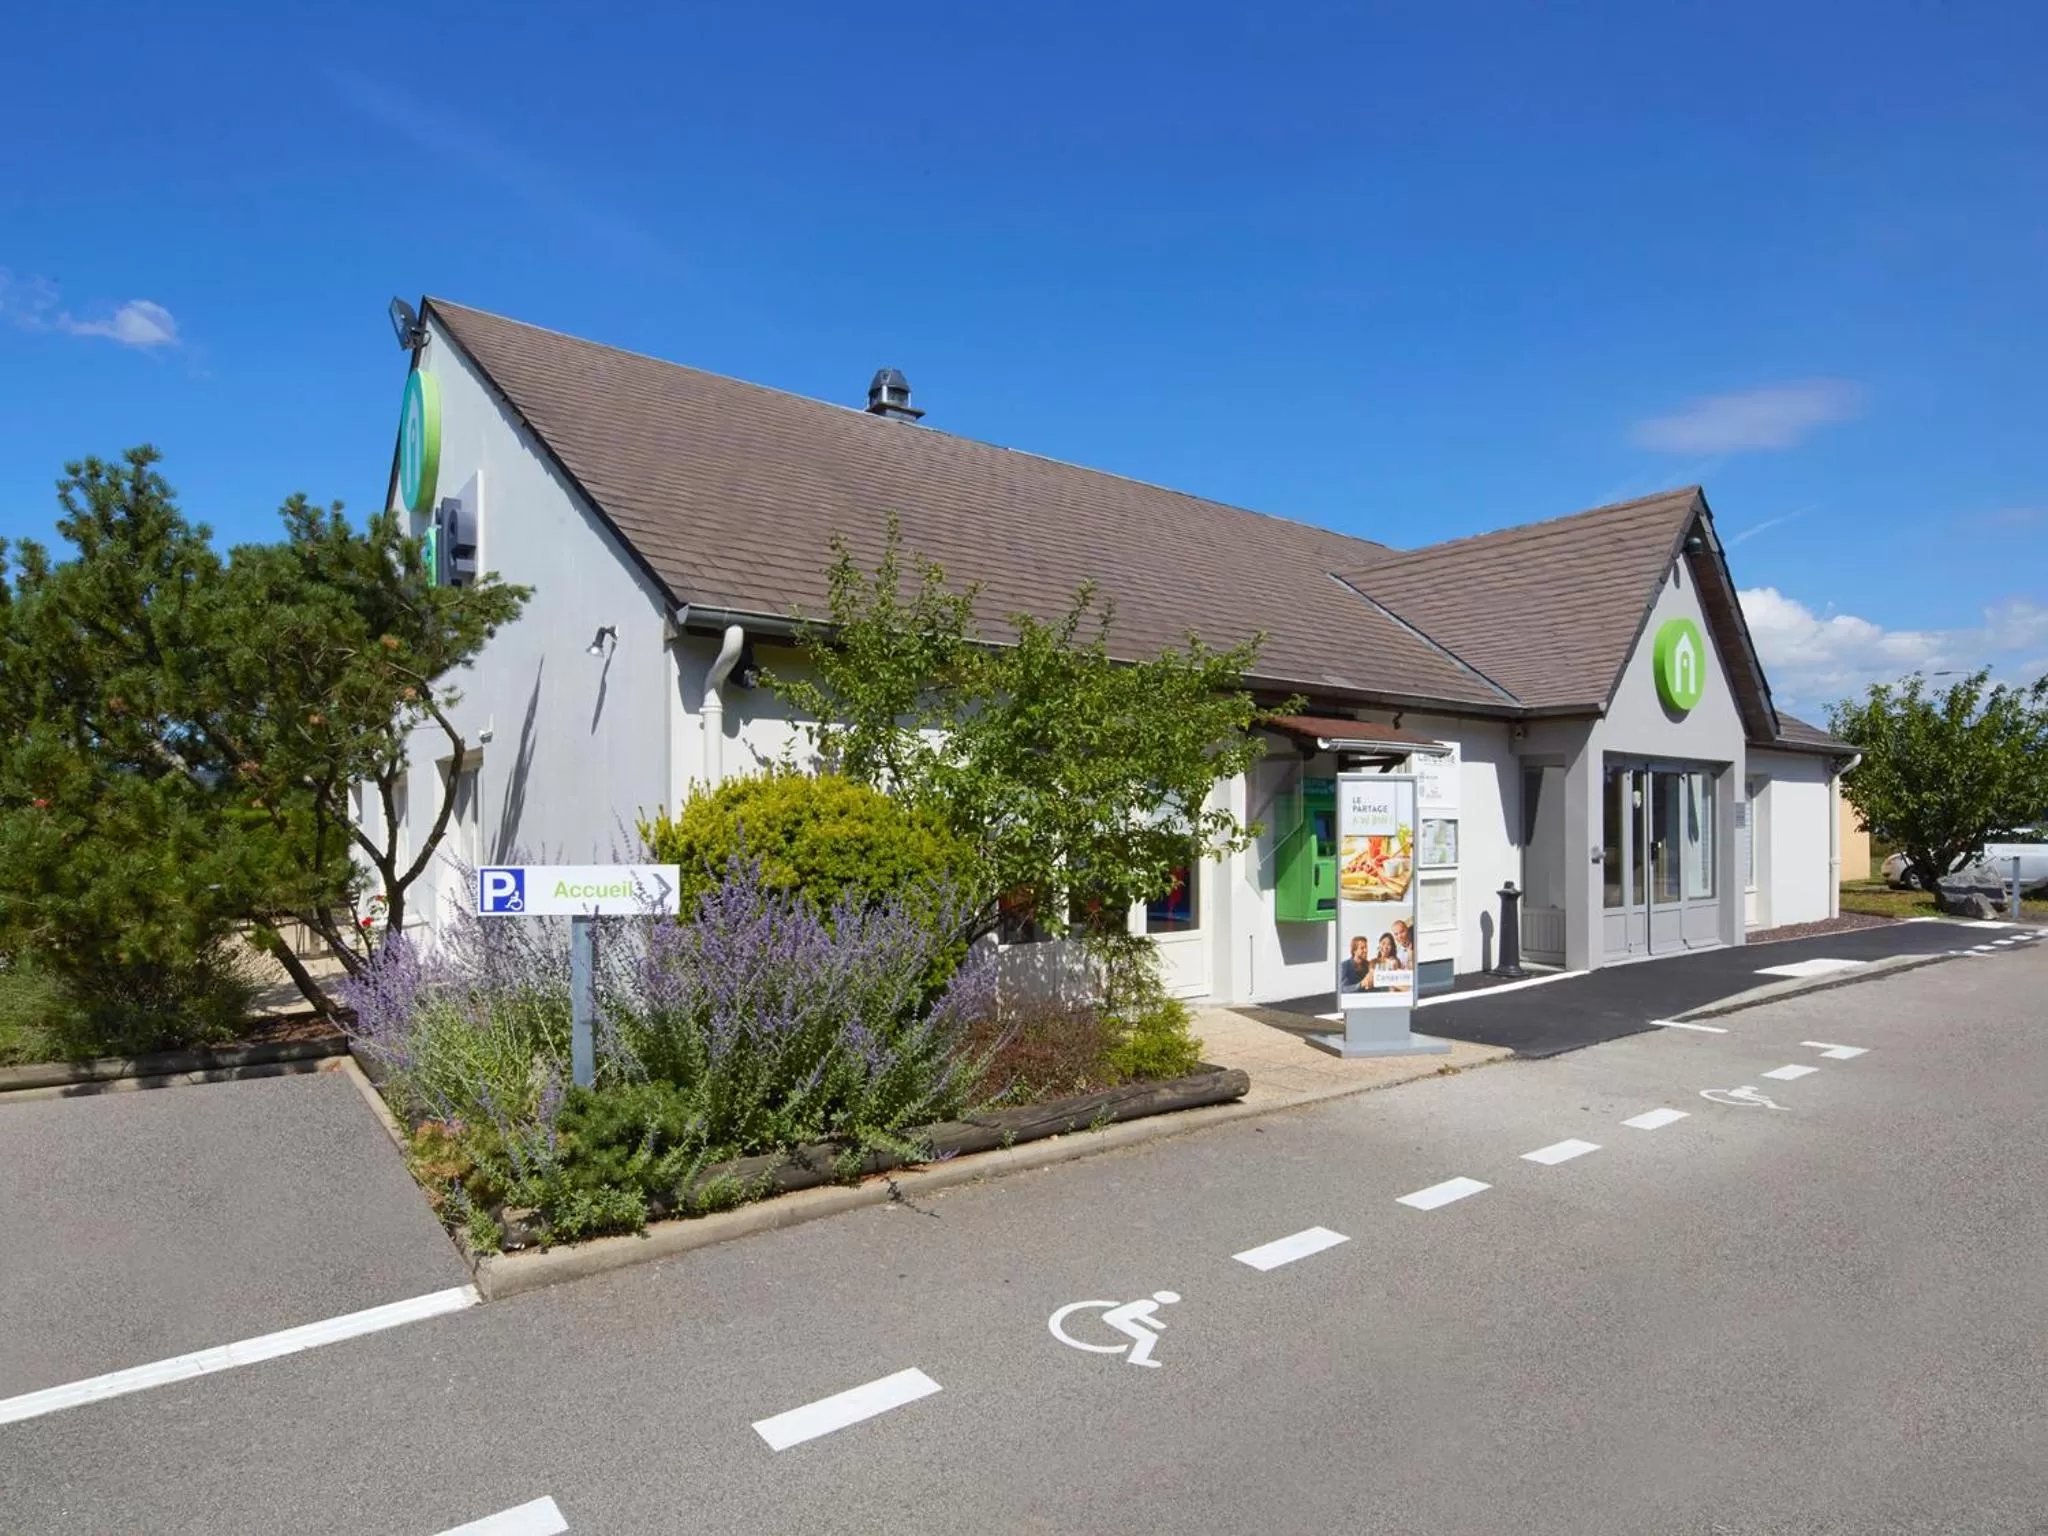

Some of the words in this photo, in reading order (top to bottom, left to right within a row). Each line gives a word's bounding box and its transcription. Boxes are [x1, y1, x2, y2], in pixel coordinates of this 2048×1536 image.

[1352, 796, 1361, 804] LE
[1352, 805, 1388, 813] PARTAGE
[483, 871, 516, 911] P
[553, 880, 633, 898] Accueil
